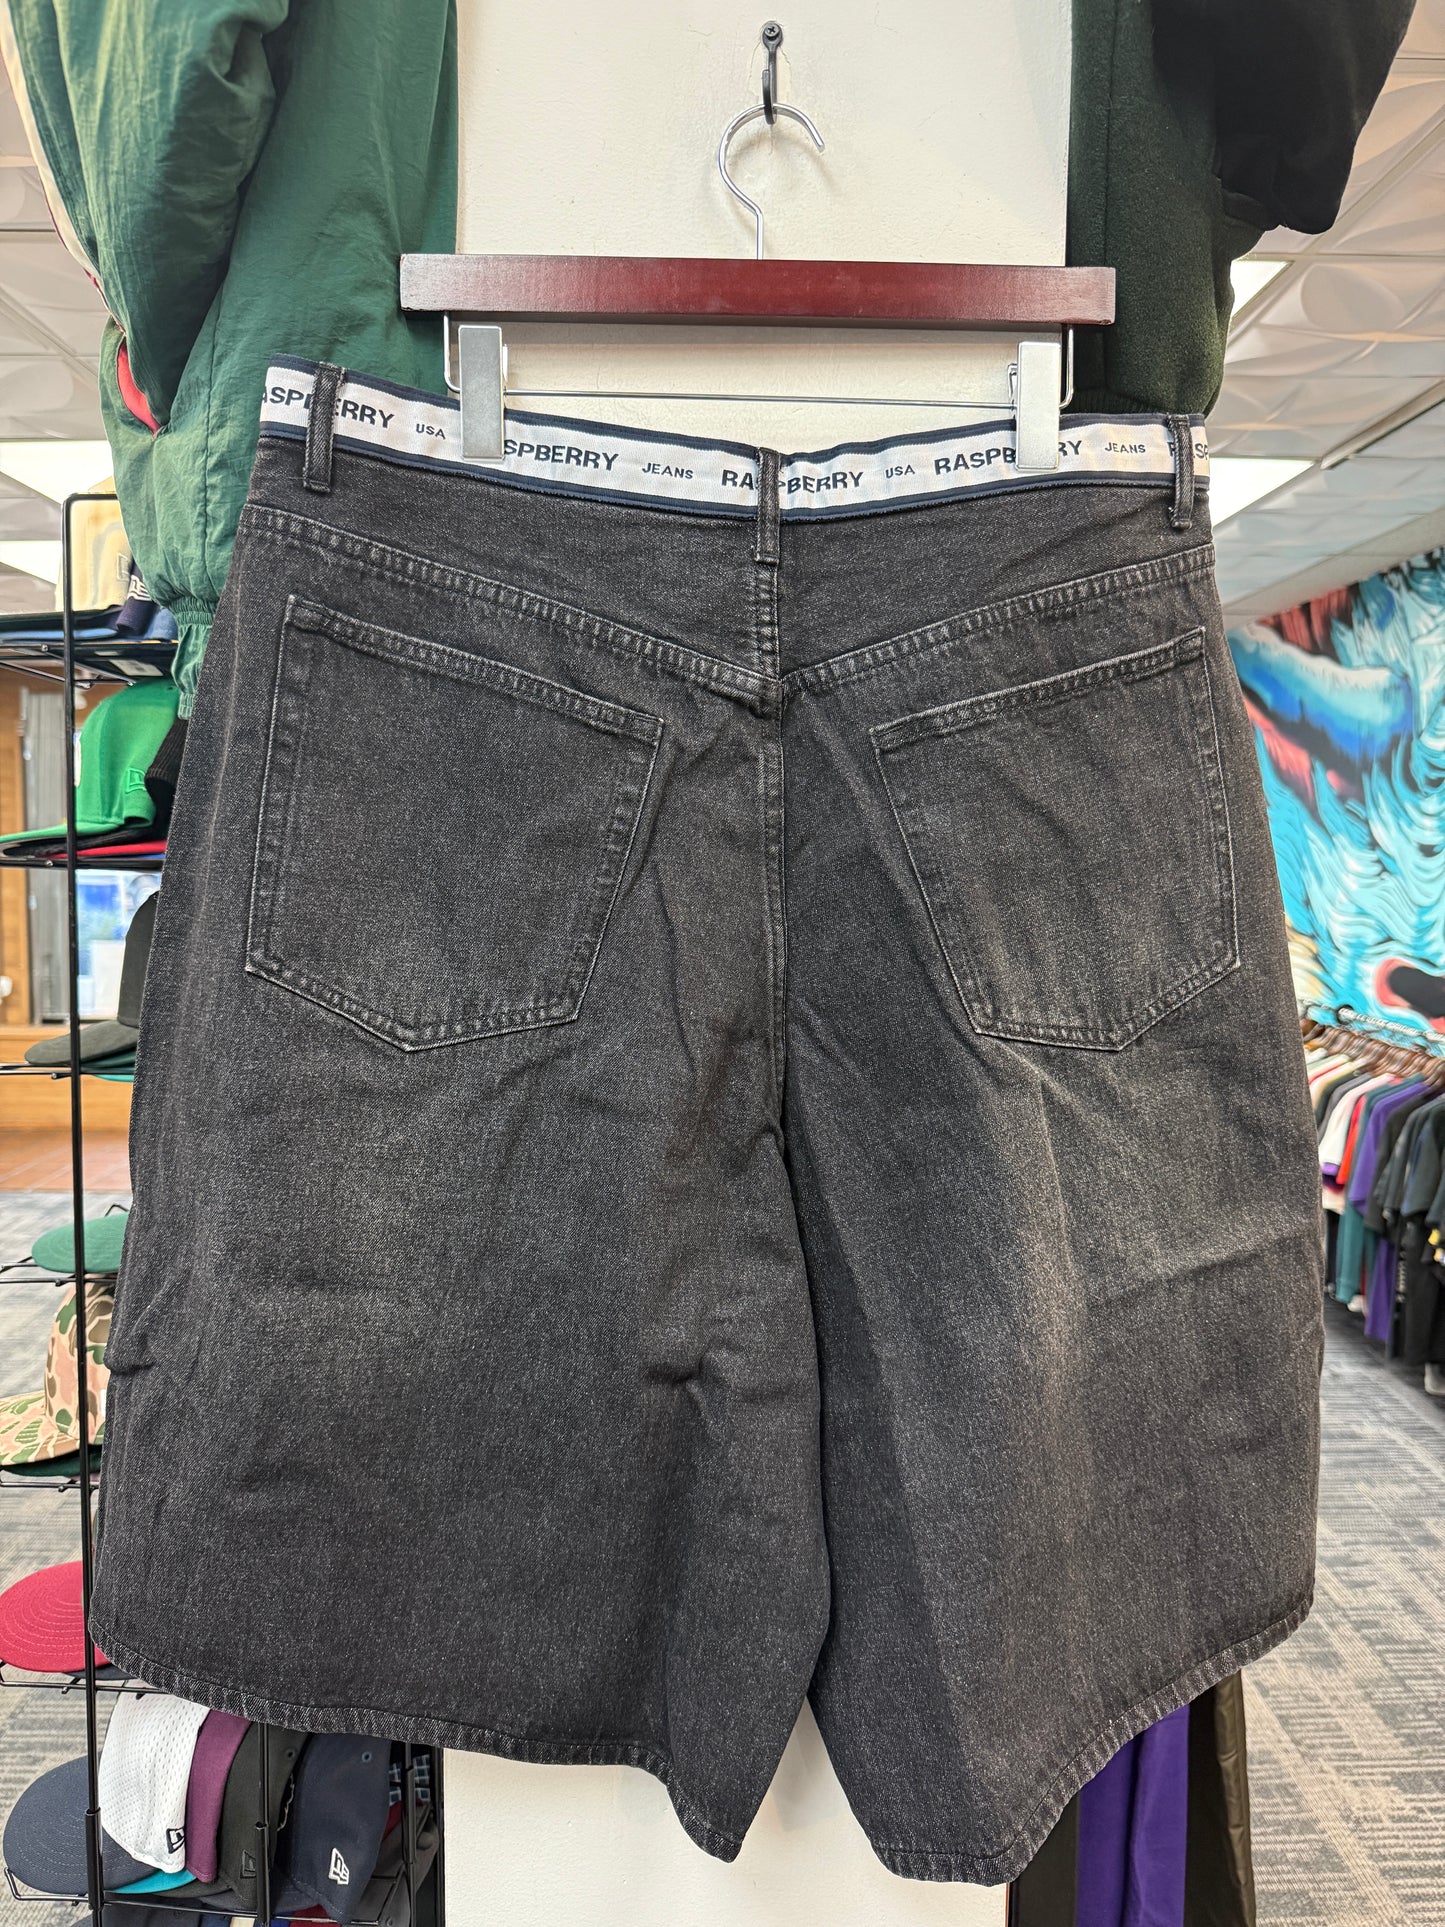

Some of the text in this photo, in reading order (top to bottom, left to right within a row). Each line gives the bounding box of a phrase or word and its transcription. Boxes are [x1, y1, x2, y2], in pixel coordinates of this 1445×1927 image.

[415, 423, 447, 440] USA
[503, 439, 620, 471] SPBERRY
[641, 462, 694, 480] JEANS
[721, 469, 864, 495] RABERRY
[885, 464, 916, 479] USA
[1104, 441, 1147, 454] JEANS
